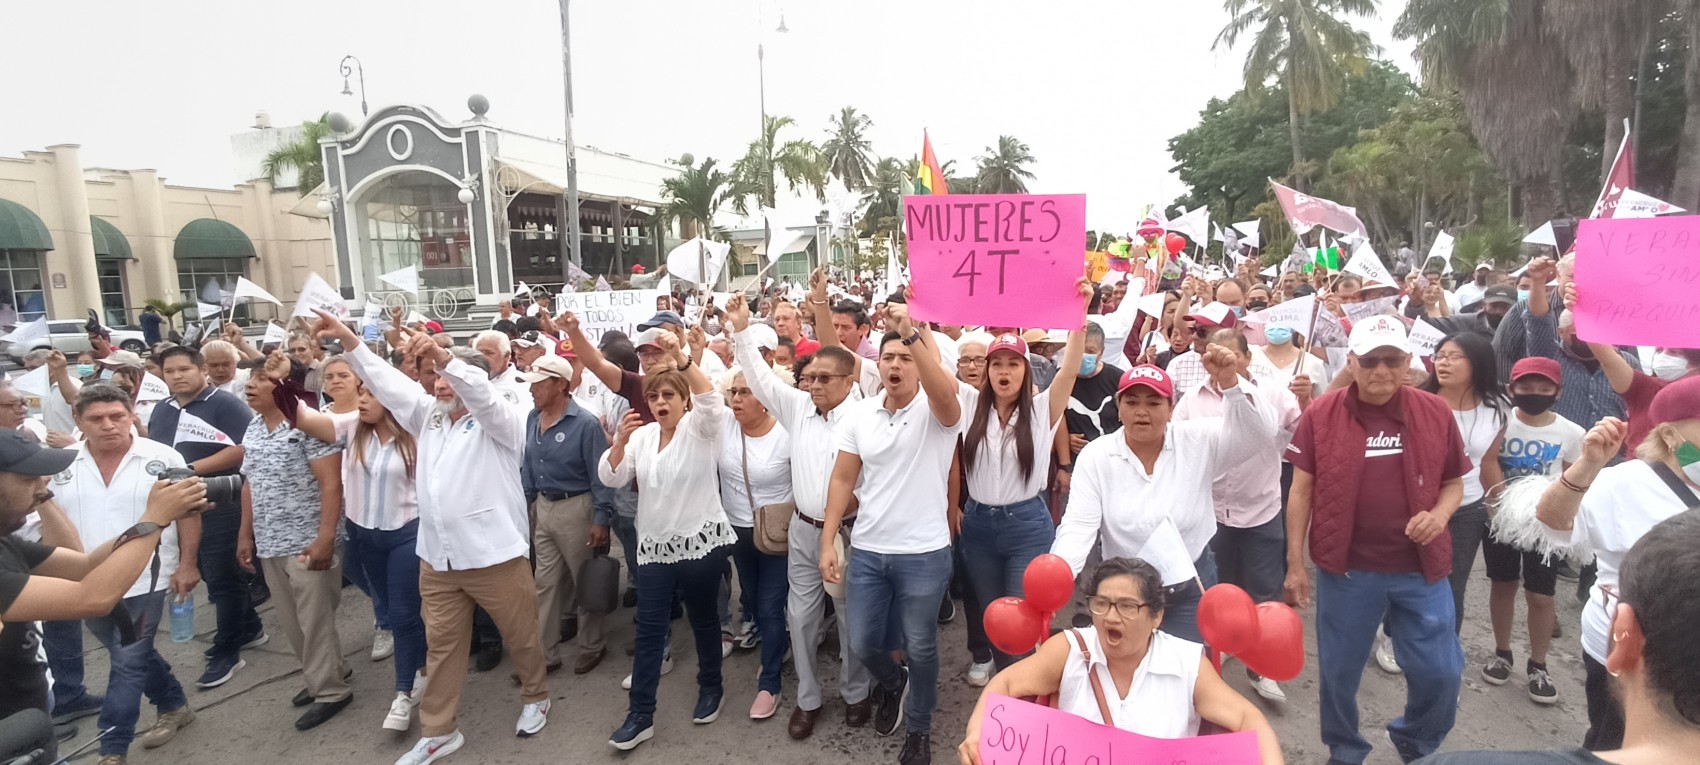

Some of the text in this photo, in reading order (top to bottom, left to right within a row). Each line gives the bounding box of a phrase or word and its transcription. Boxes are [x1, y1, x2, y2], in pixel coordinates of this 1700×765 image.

[907, 199, 1061, 243] MUJERES
[1598, 228, 1700, 256] VERA
[1358, 262, 1378, 278] AMLO
[557, 291, 641, 310] POR EL BIEN
[584, 309, 624, 323] TODOS
[1421, 341, 1436, 350] AM
[179, 422, 215, 435] VERACRUZ
[190, 428, 216, 441] AMLO
[987, 704, 1030, 765] Soy
